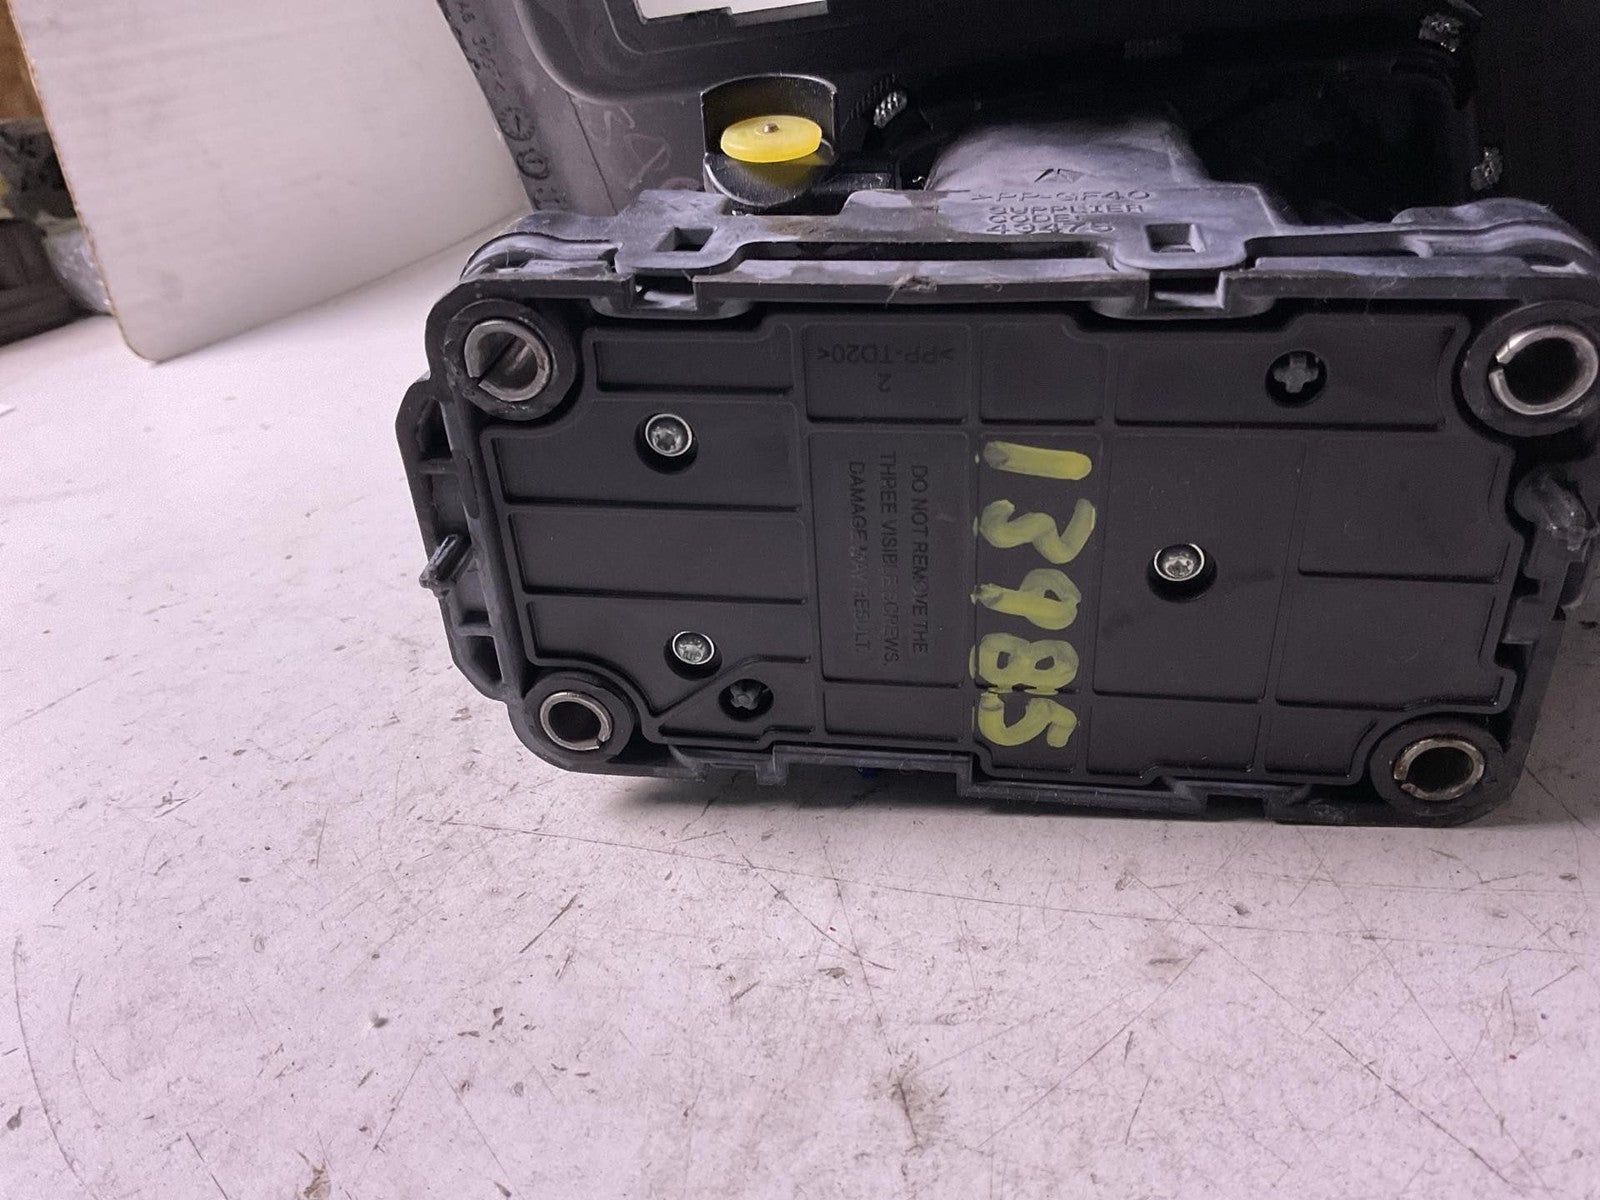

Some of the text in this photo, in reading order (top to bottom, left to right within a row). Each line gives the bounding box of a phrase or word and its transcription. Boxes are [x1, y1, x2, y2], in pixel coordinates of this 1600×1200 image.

[988, 203, 1145, 215] SUPPLIER
[848, 461, 868, 541] DAMAGE
[880, 451, 898, 513] THREE
[911, 465, 929, 654] DO NOT REMOVE THE
[970, 440, 1096, 748] 13985
